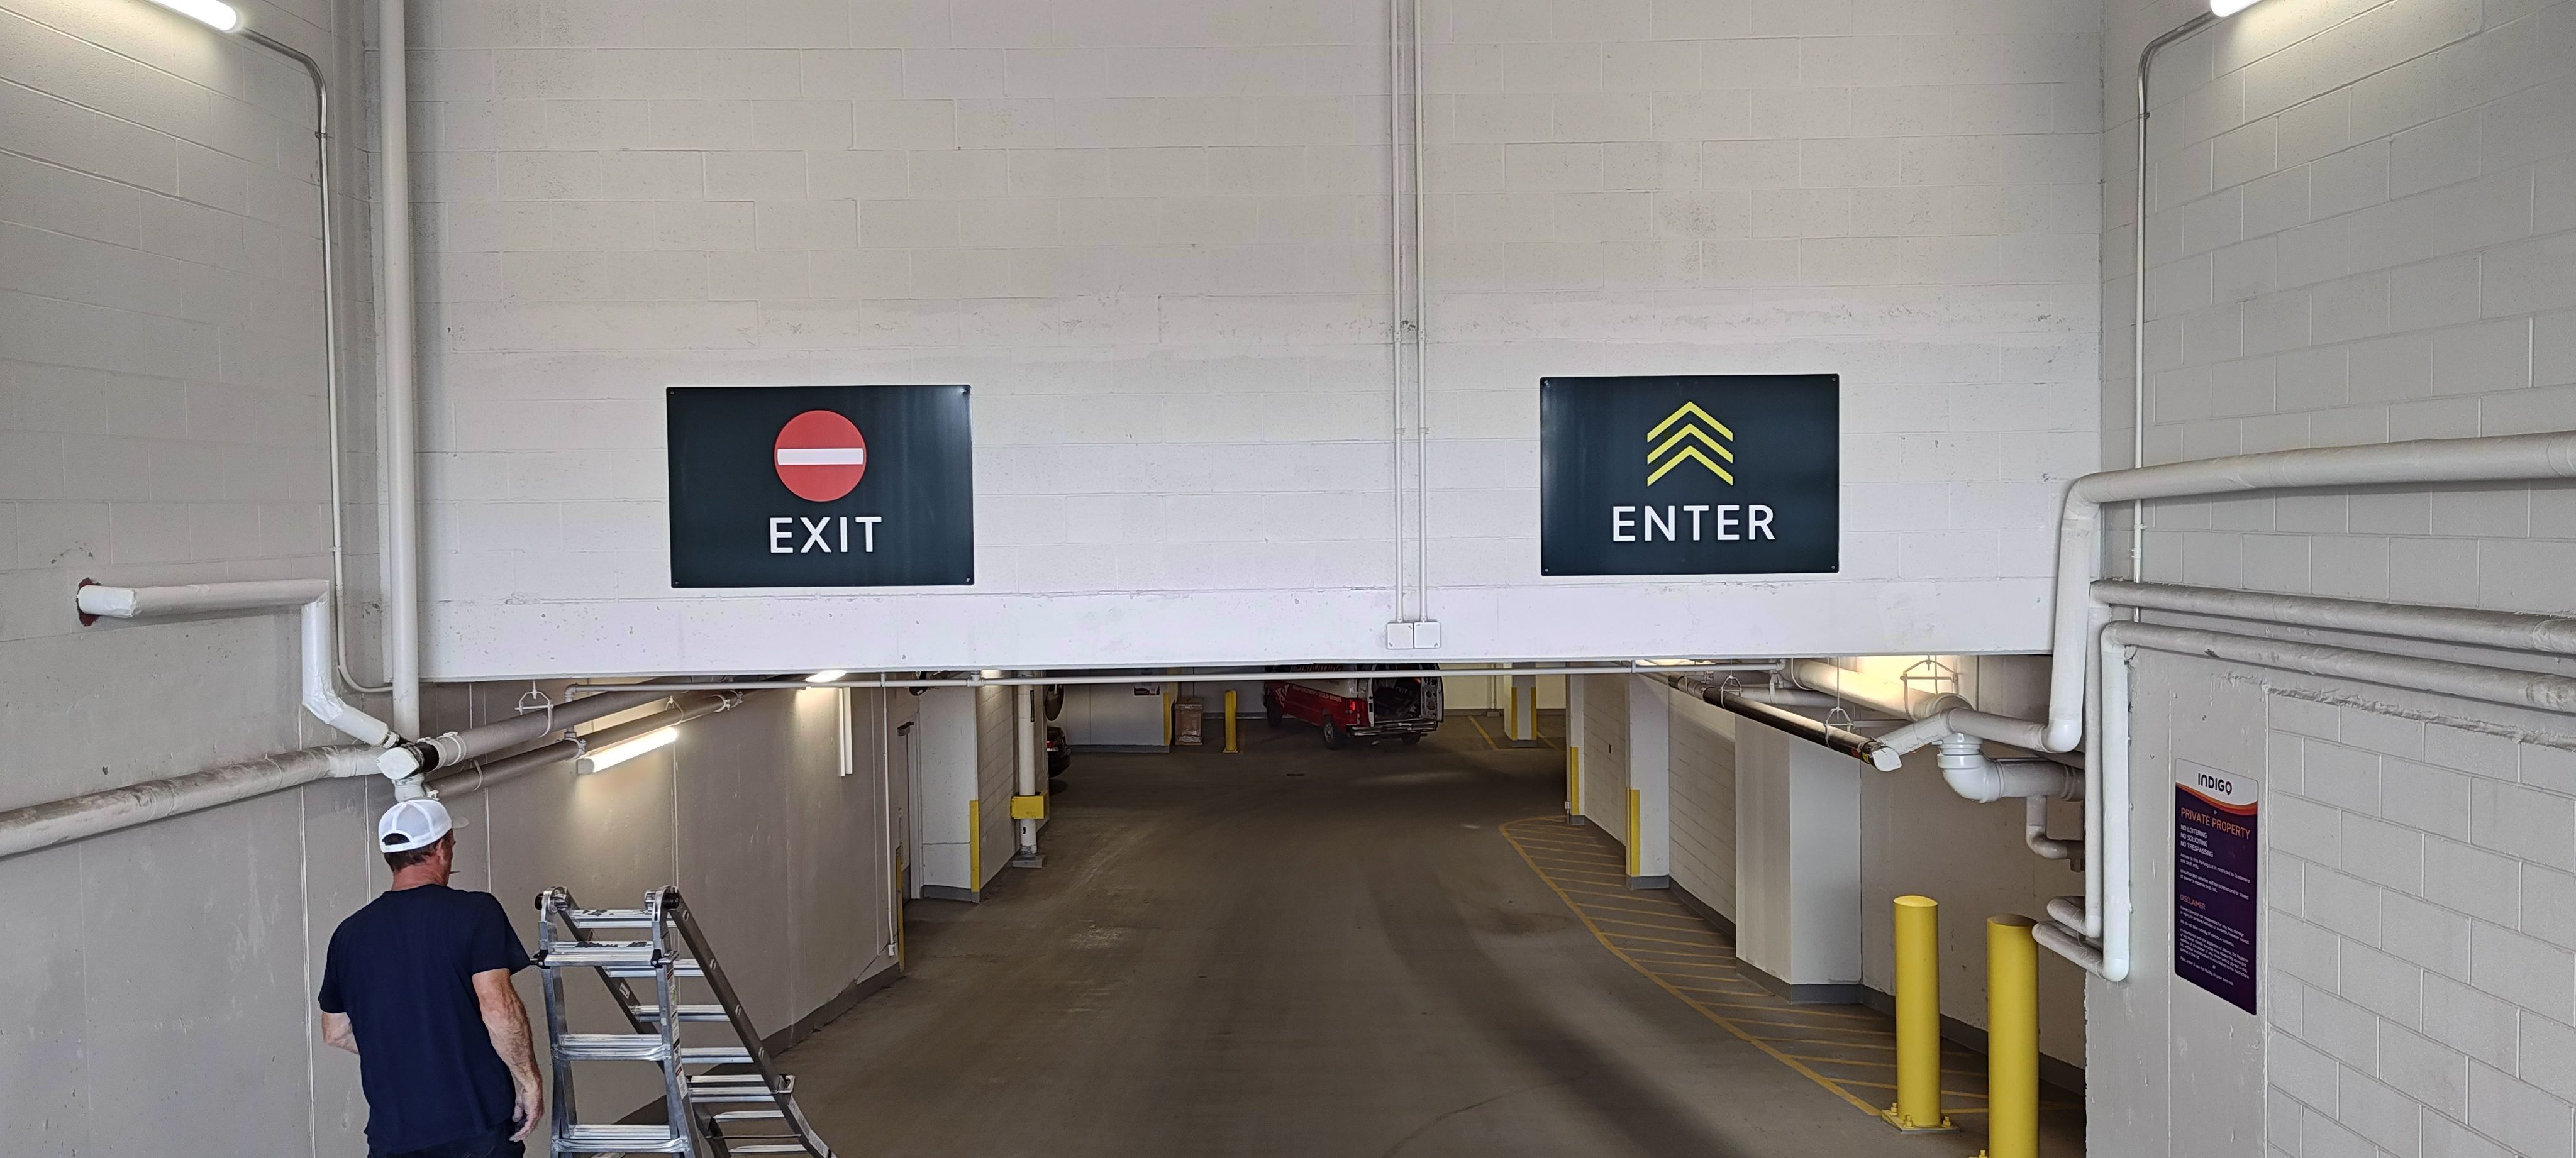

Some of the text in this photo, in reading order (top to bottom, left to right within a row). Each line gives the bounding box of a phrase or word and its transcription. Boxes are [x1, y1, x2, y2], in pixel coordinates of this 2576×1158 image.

[1613, 504, 1775, 542] ENTER
[770, 517, 882, 553] EXIT
[2181, 807, 2251, 840] PRIVATE PROPERTY
[2187, 826, 2207, 839] LOITERING
[2187, 834, 2208, 847] SOLICITING
[2187, 842, 2214, 857] TRESPASSING
[2180, 894, 2206, 910] DISCLAIMER
